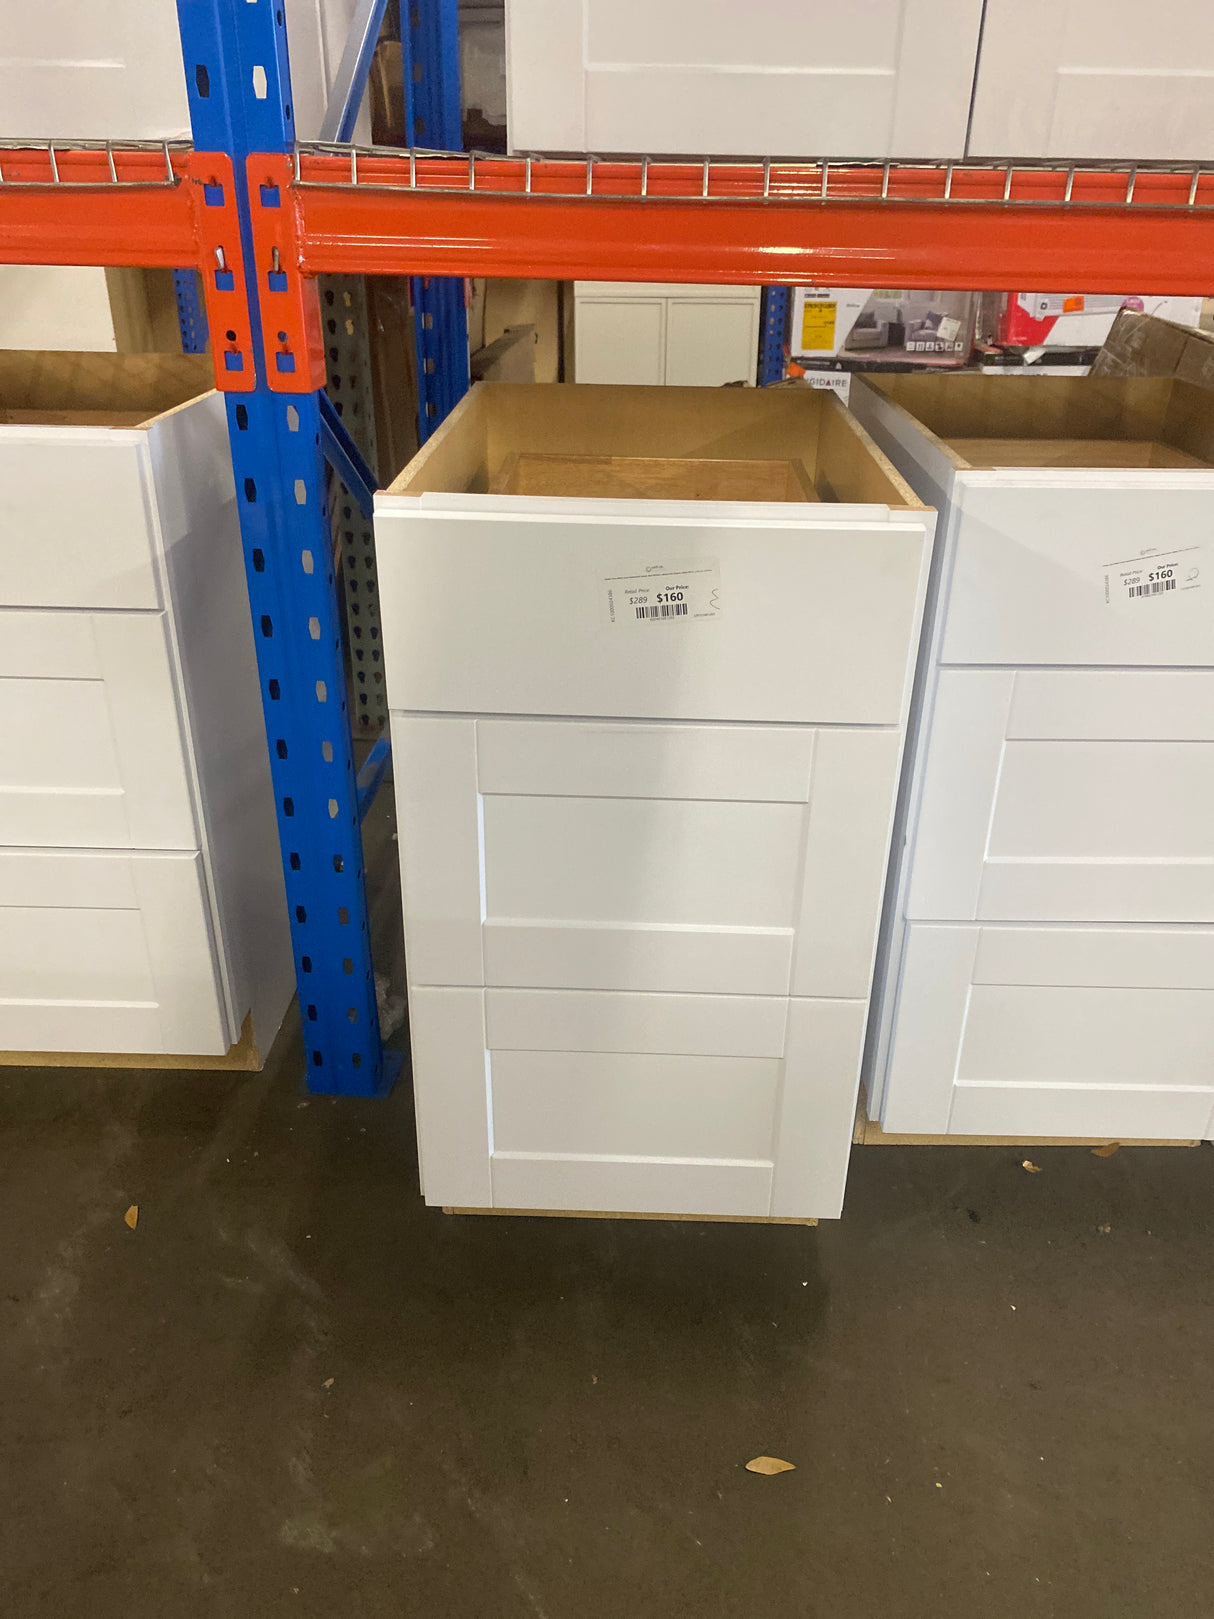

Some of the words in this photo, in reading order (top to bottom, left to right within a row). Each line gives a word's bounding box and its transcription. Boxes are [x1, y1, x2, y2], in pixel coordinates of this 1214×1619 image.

[1148, 569, 1173, 581] $160
[1123, 577, 1141, 586] $289
[629, 596, 648, 605] $289
[656, 591, 684, 604] $160
